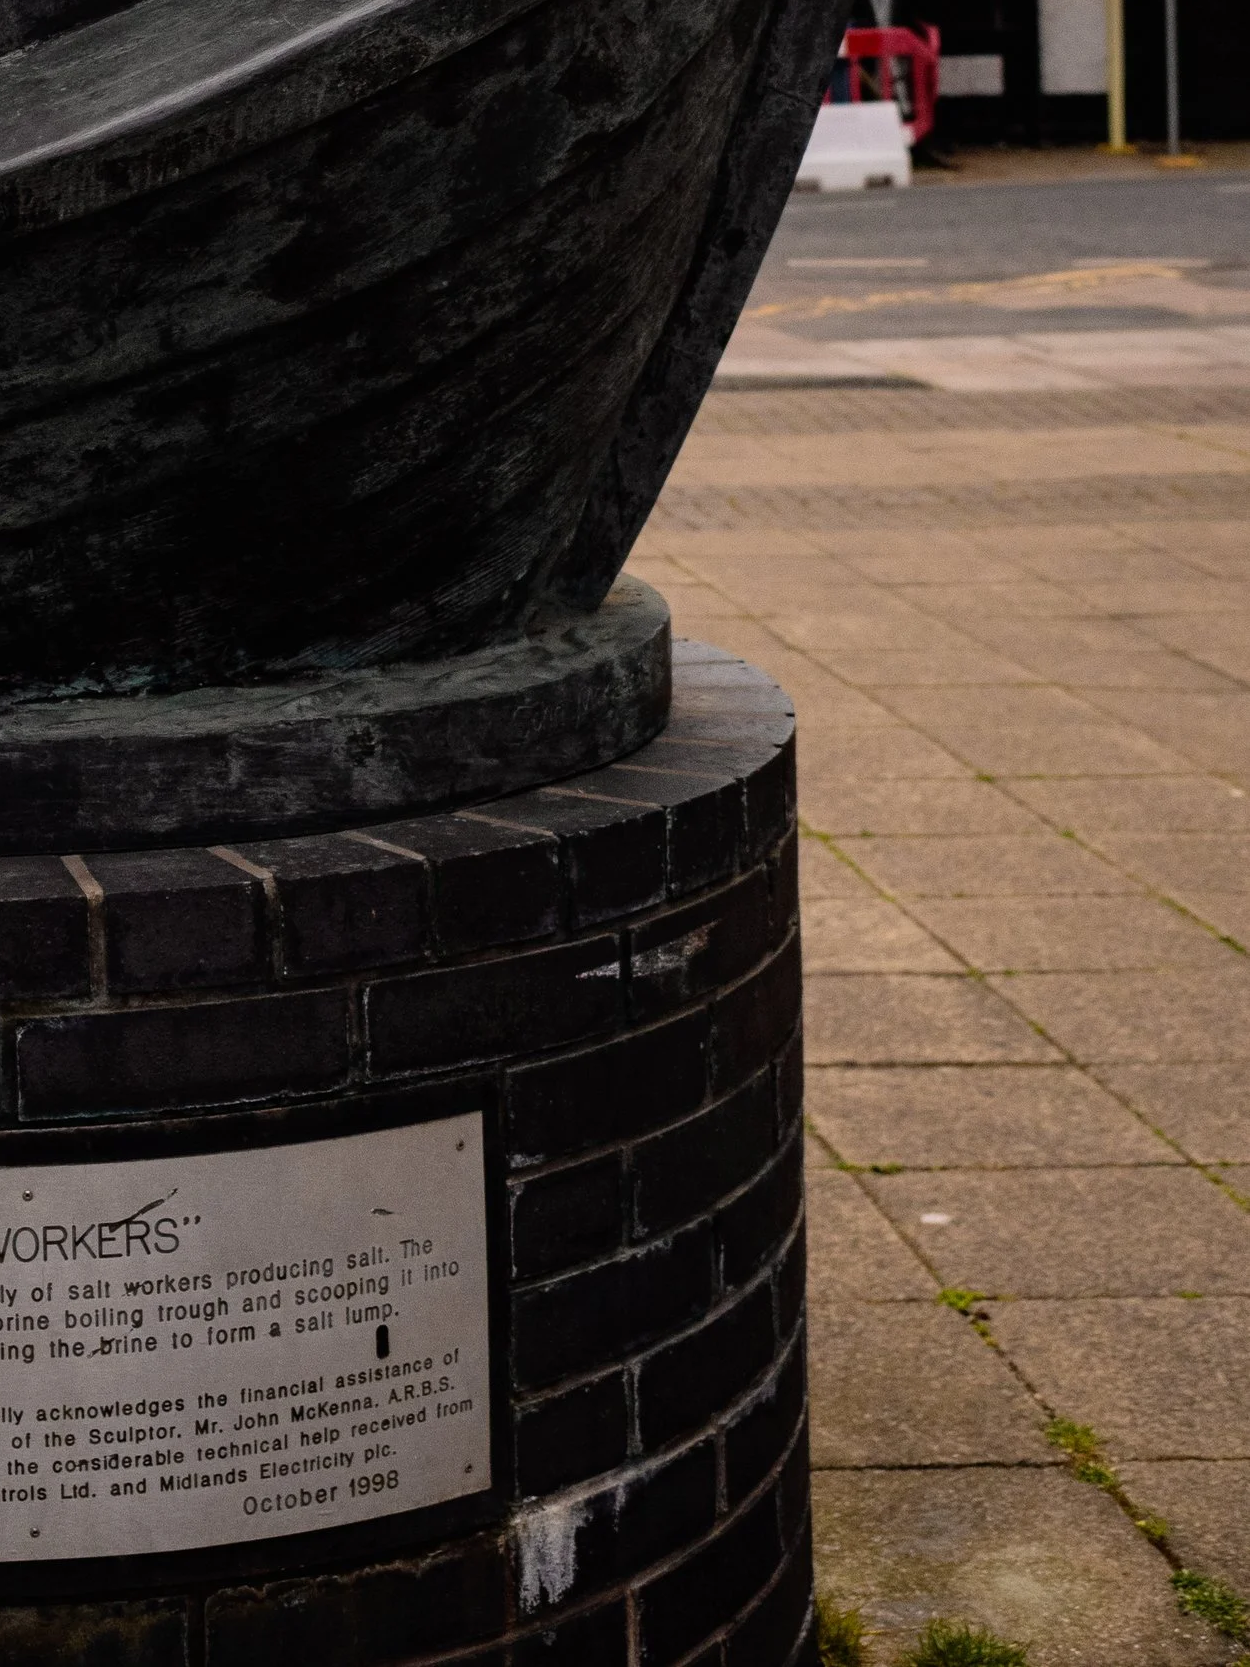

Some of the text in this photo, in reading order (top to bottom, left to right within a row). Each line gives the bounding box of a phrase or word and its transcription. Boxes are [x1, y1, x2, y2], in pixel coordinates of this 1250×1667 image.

[30, 1282, 53, 1303] of
[68, 1279, 111, 1301] salt
[123, 1273, 212, 1297] workers
[226, 1257, 334, 1290] producing
[346, 1246, 390, 1270] salt.
[400, 1238, 433, 1260] The
[64, 1307, 144, 1329] boiling
[157, 1296, 229, 1323] trough
[242, 1289, 281, 1314] and
[294, 1275, 389, 1306] scooping
[401, 1269, 412, 1286] it
[424, 1260, 460, 1281] into
[49, 1338, 86, 1359] the
[100, 1335, 157, 1356] brine
[171, 1332, 193, 1350] to
[207, 1325, 256, 1346] form
[268, 1321, 282, 1338] a
[294, 1310, 333, 1334] salt
[345, 1303, 400, 1325] lump.
[11, 1432, 32, 1450] of
[43, 1431, 76, 1448] the
[194, 1418, 224, 1436] Mr.
[233, 1412, 279, 1432] John
[388, 1376, 455, 1405] A.R.B.S.
[35, 1397, 186, 1422] acknowledges
[197, 1392, 228, 1410] the
[240, 1375, 324, 1404] financial
[335, 1357, 433, 1390] assistance
[442, 1347, 459, 1366] of
[6, 1459, 39, 1476] the
[51, 1449, 185, 1474] considerable
[196, 1433, 289, 1462] technical
[299, 1426, 341, 1447] help
[351, 1406, 427, 1438] received
[436, 1398, 473, 1419] from
[109, 1477, 147, 1497] and
[159, 1467, 248, 1492] Midlands
[259, 1451, 355, 1480] Electricity
[364, 1443, 397, 1463] plc.
[243, 1470, 400, 1516] October 1998
